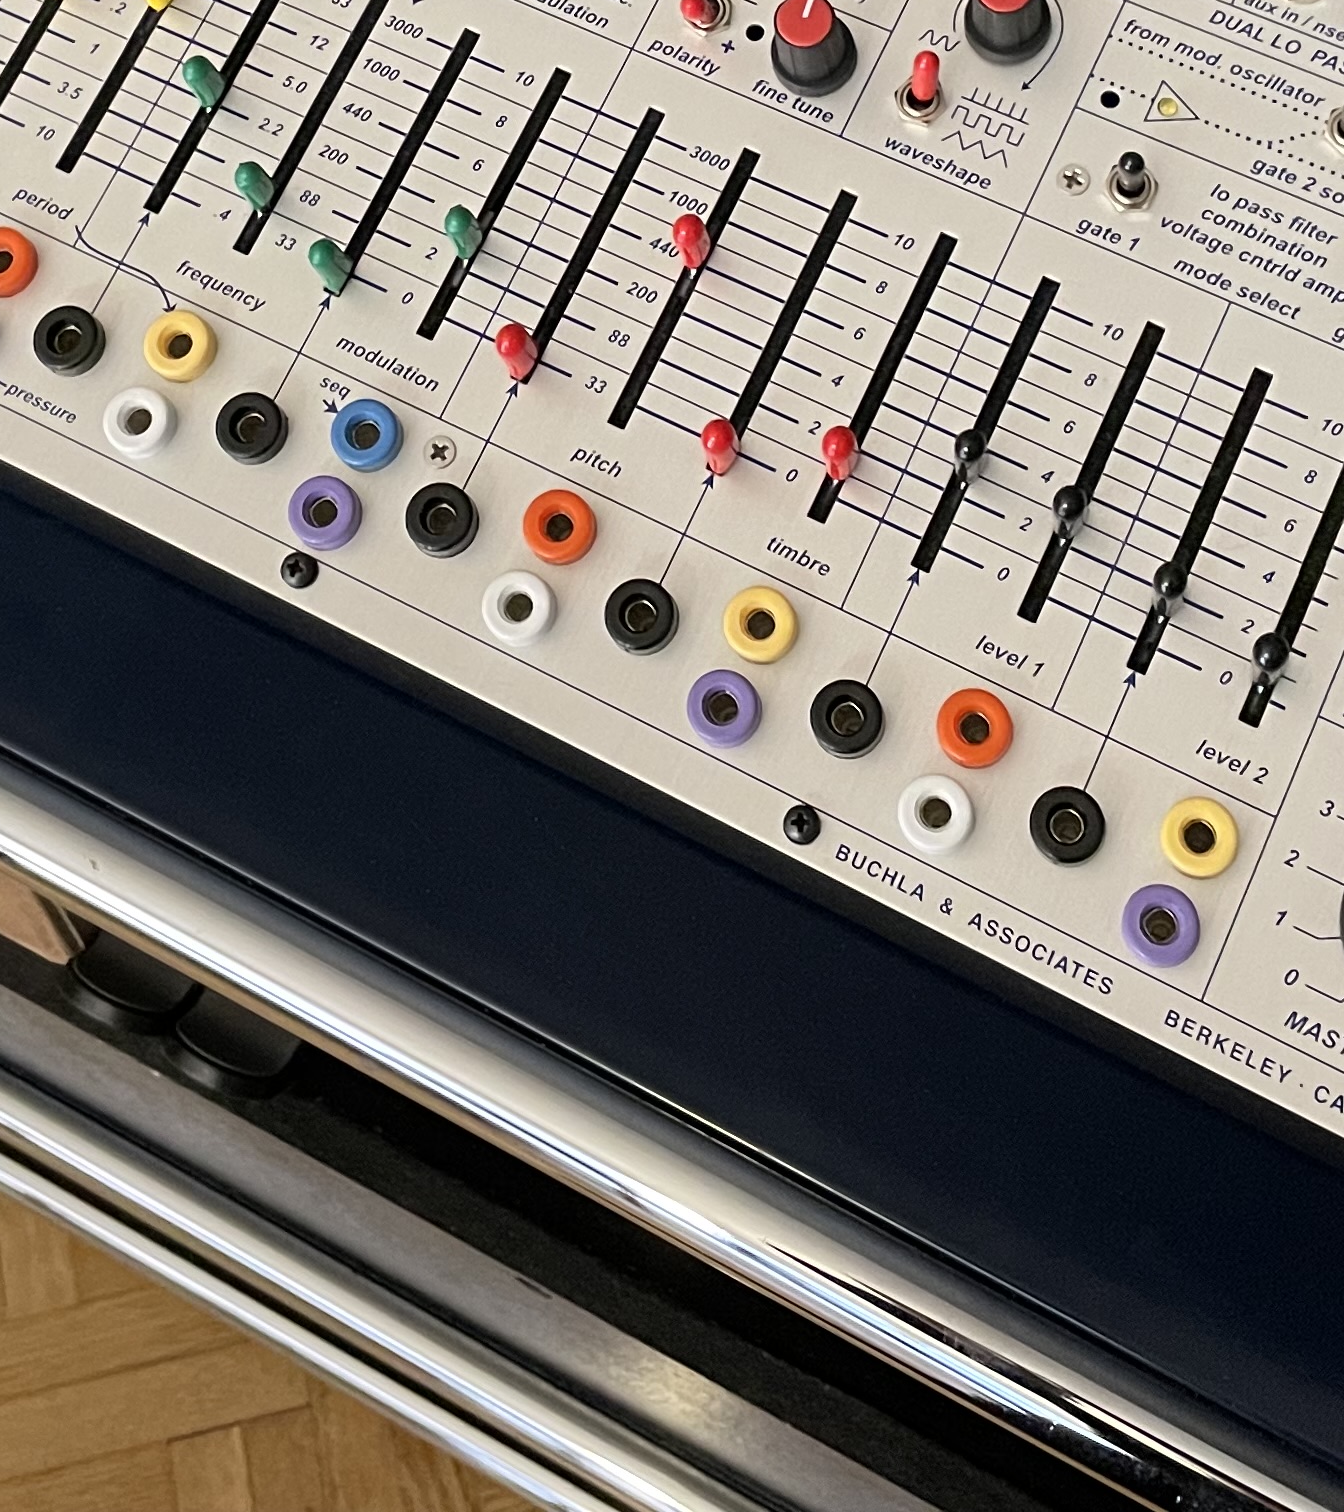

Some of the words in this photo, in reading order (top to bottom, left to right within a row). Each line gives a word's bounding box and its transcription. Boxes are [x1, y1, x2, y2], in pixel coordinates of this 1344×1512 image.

[647, 39, 722, 76] polarity
[1208, 9, 1265, 41] DUAL
[1268, 33, 1303, 55] LO
[1124, 19, 1172, 47] from
[1174, 41, 1223, 69] mod.
[1229, 62, 1327, 109] oscillator
[884, 136, 992, 190] waveshape
[10, 187, 75, 222] period
[298, 189, 321, 207] 88
[1160, 217, 1235, 258] voltage
[1238, 247, 1302, 285] cntrld
[1201, 208, 1329, 269] combination
[176, 259, 267, 313] frequency
[1173, 258, 1235, 292] mode
[1238, 285, 1303, 322] select
[334, 334, 442, 394] modulation
[4, 382, 79, 425] pressure
[766, 535, 832, 577] timbre
[834, 842, 927, 903] BUCHLA
[938, 897, 956, 916] &
[966, 911, 1115, 996] ASSOCIATES
[1163, 1008, 1292, 1084] BERKELEY
